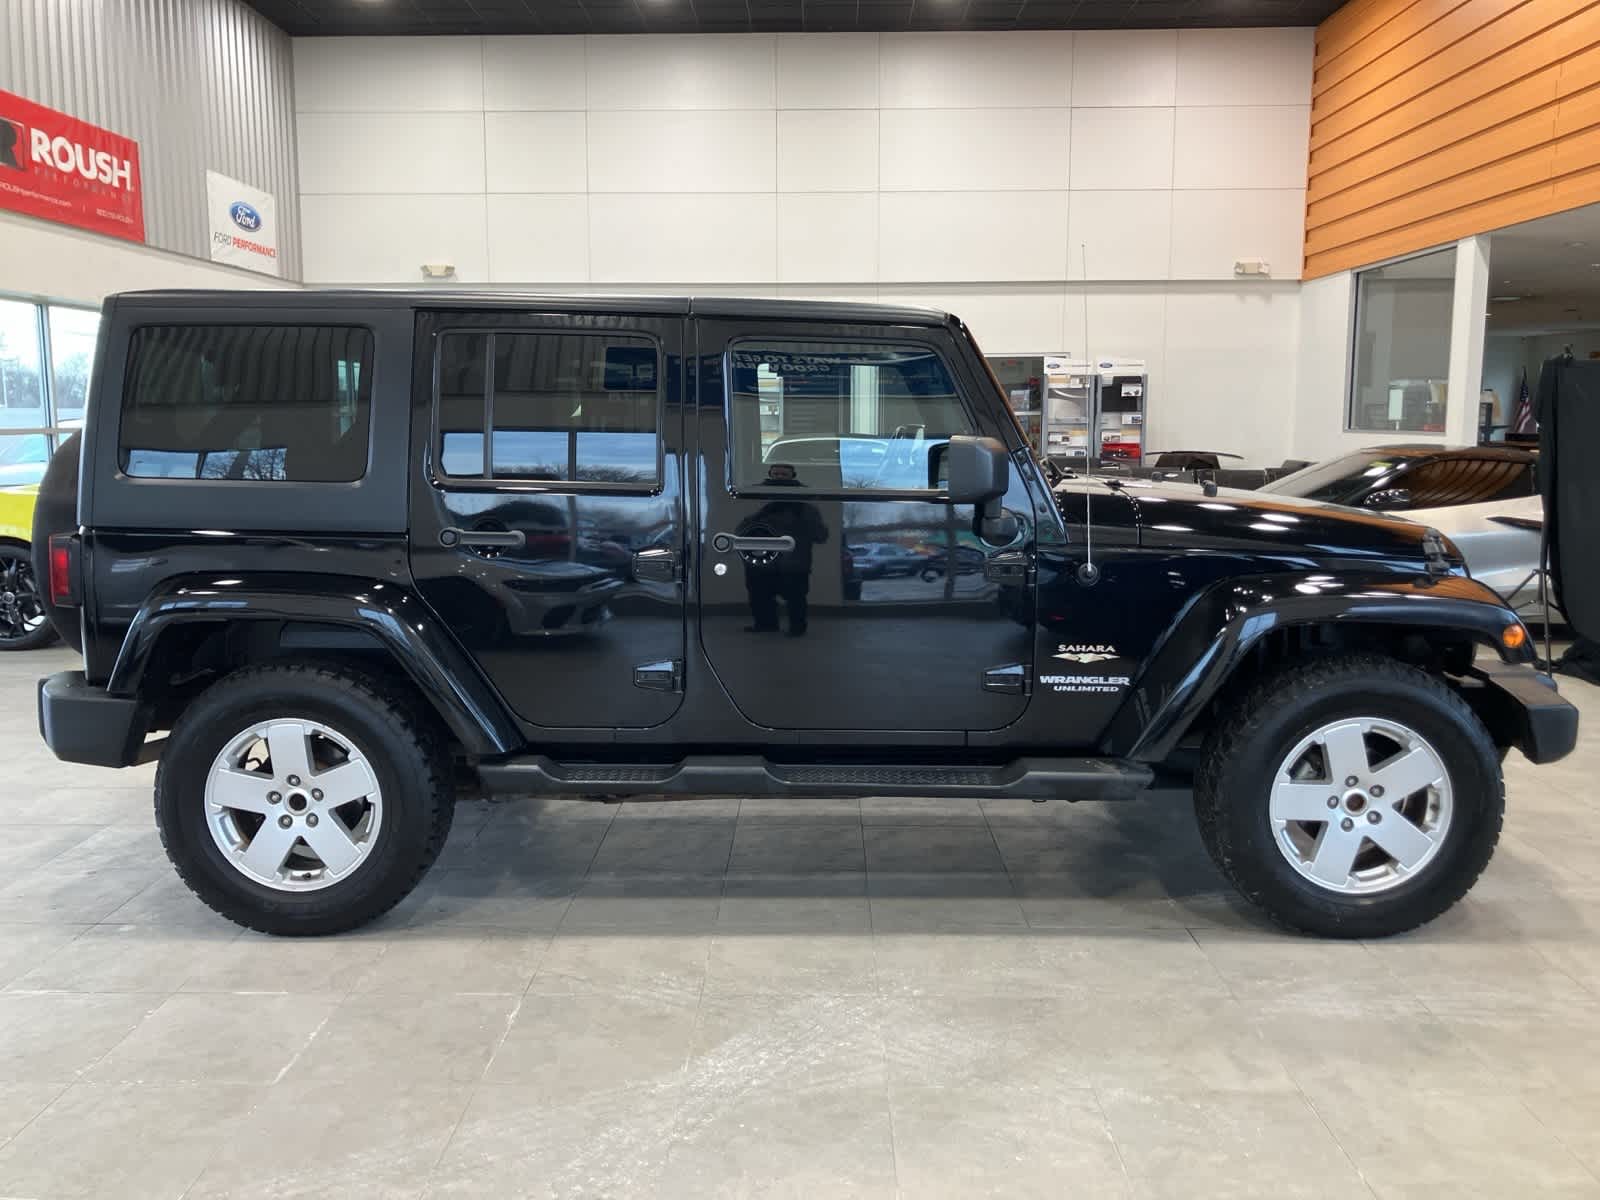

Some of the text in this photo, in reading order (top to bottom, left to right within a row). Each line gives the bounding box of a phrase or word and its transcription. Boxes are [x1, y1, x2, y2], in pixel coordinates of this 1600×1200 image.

[30, 127, 131, 191] ROUSH
[236, 206, 256, 228] Ford
[213, 231, 232, 246] FORD
[1058, 644, 1116, 653] SAHARA
[1039, 675, 1131, 686] WRANGLER
[1053, 685, 1120, 693] UNLIMITED
